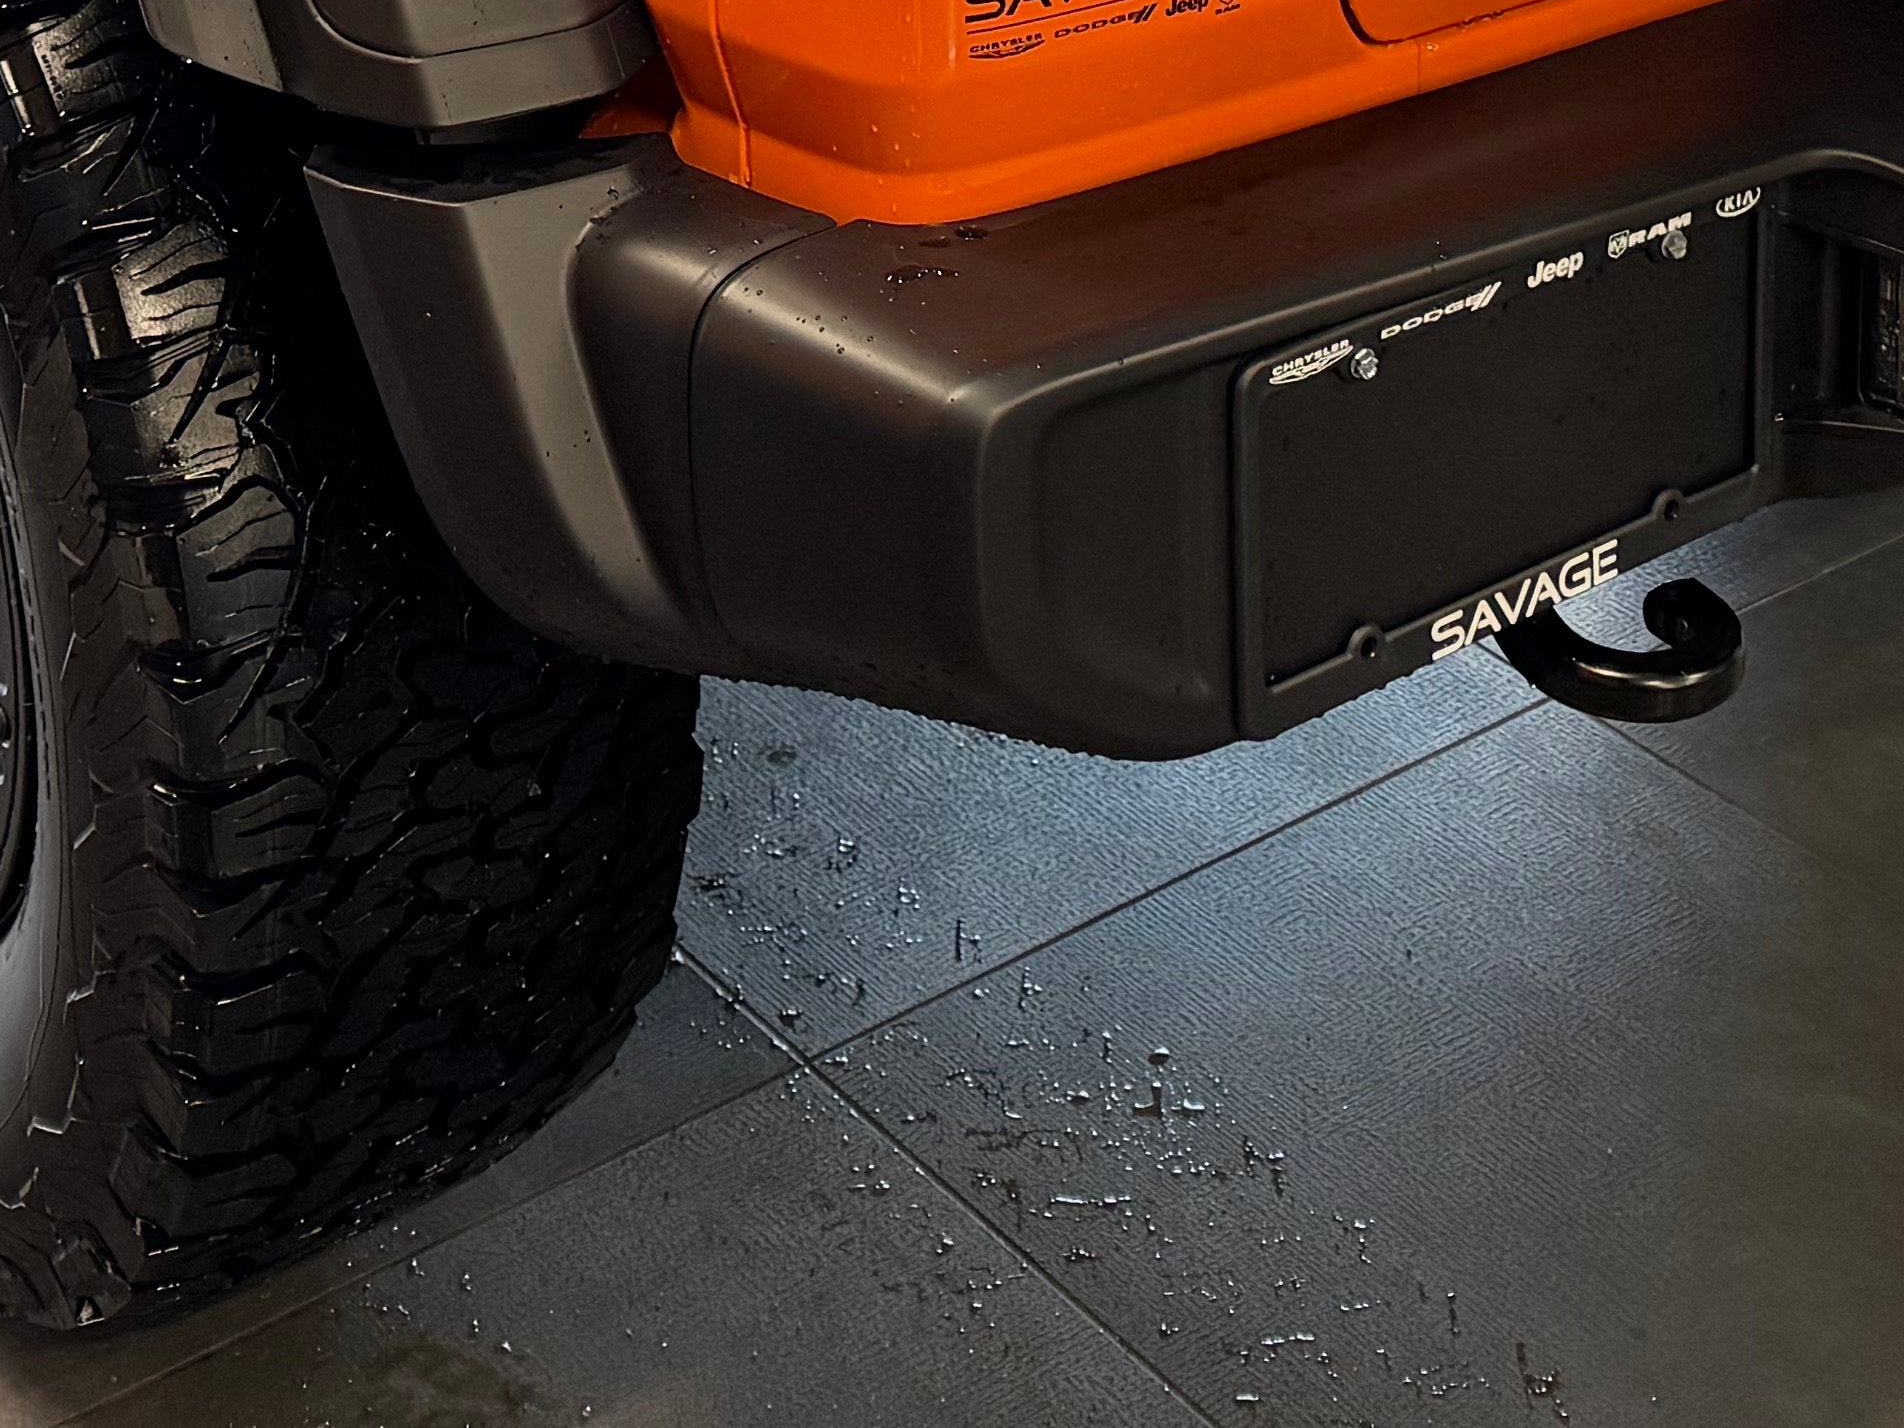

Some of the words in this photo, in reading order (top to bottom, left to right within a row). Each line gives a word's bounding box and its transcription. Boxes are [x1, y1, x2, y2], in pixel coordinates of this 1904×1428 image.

[969, 32, 1044, 54] CHRYSLER
[1272, 338, 1351, 377] CHRYSLER
[1380, 293, 1484, 340] DODGE
[1527, 250, 1584, 289] Jeep
[1628, 210, 1693, 248] RAM
[1724, 190, 1753, 214] KIA
[1431, 537, 1620, 662] SAVAGE
